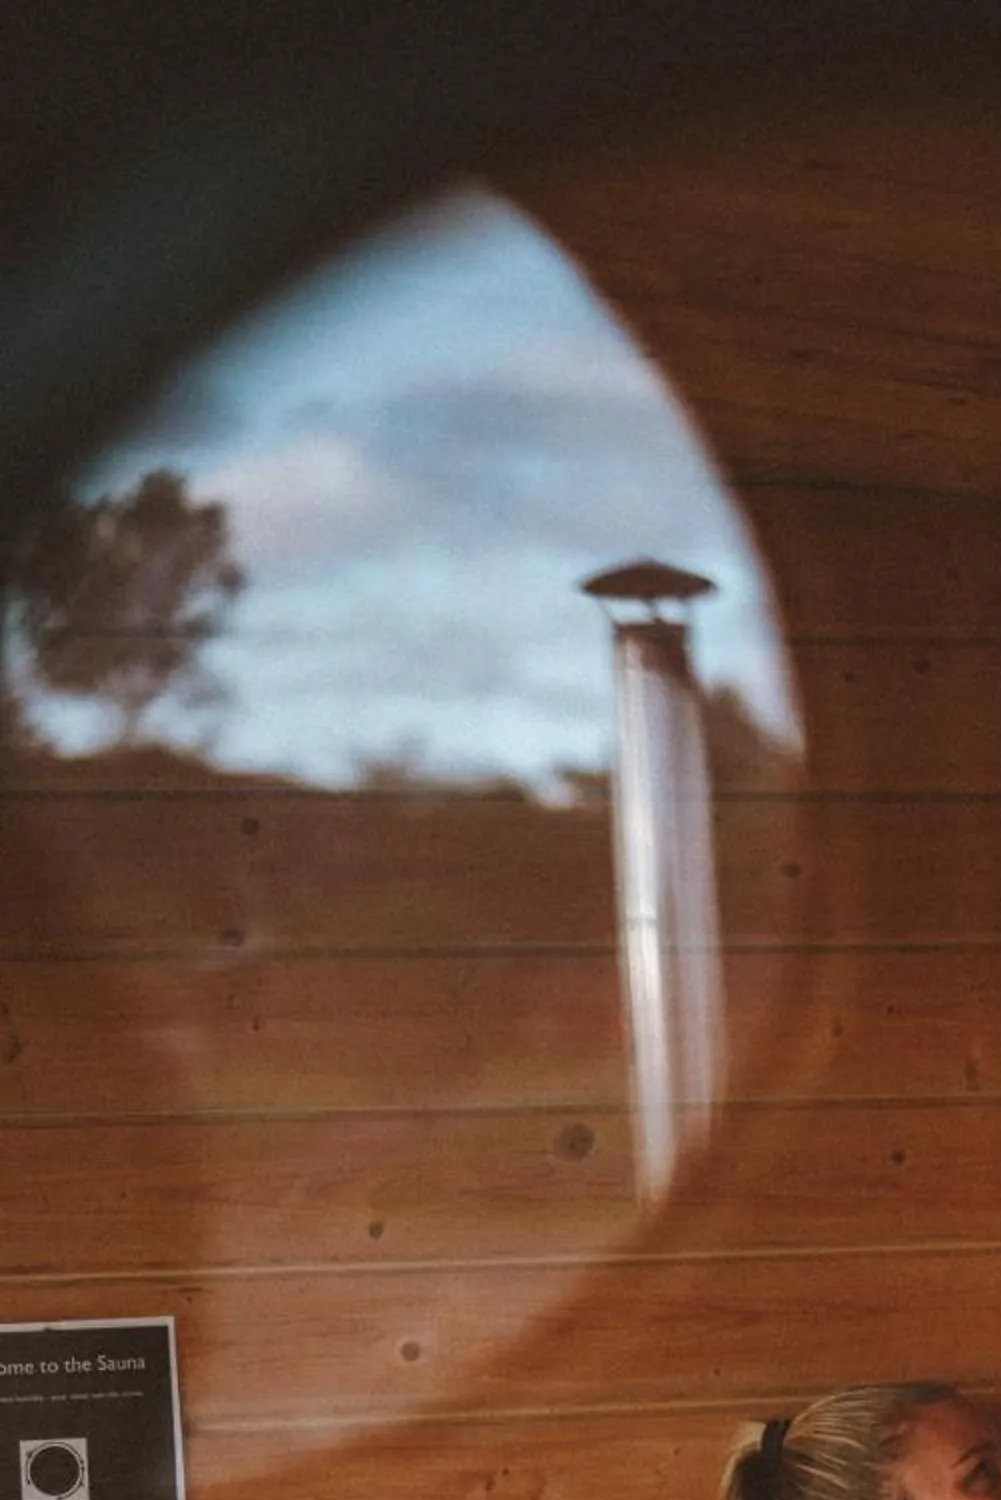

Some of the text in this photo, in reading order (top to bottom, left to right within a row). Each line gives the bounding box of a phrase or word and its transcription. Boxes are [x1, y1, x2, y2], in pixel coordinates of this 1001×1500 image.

[40, 1360, 59, 1374] to
[64, 1355, 92, 1373] the
[97, 1354, 146, 1371] Sauna
